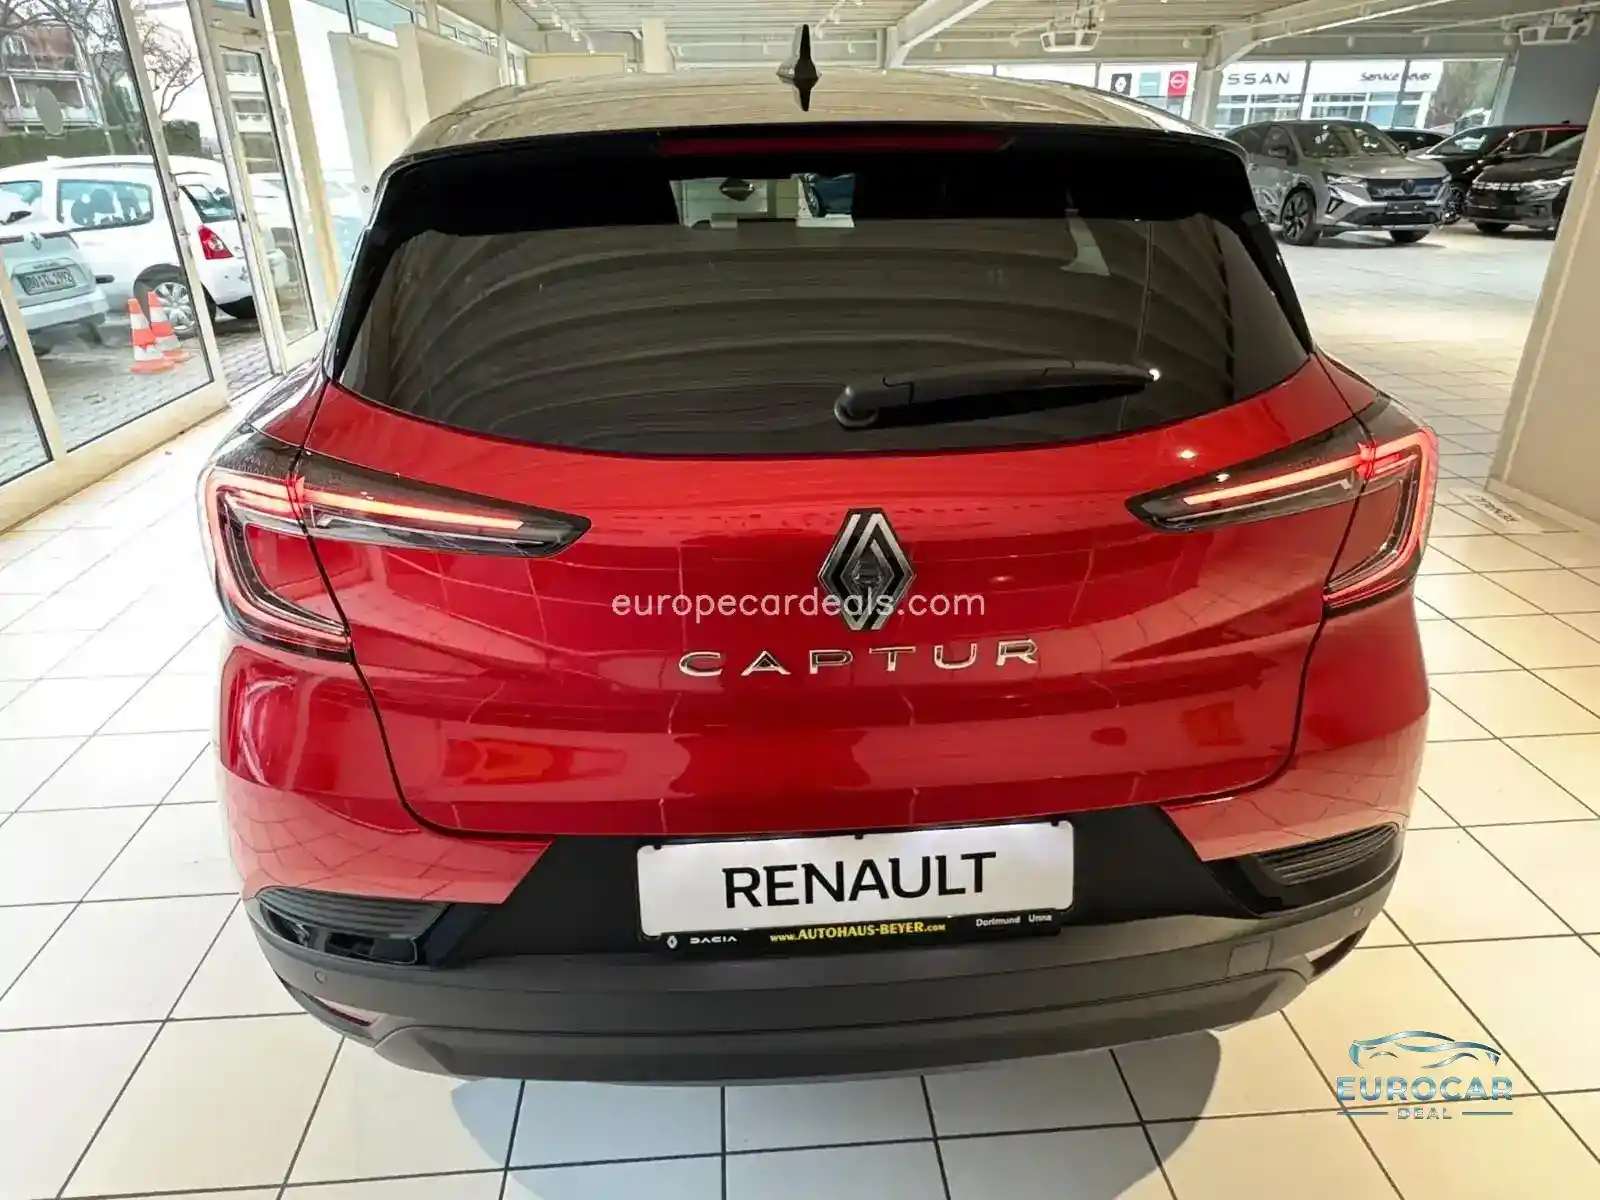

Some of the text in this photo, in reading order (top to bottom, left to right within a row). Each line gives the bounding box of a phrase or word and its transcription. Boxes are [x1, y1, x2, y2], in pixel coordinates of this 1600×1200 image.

[1227, 72, 1290, 86] SSAN
[678, 638, 1039, 677] CAPTUR
[722, 851, 996, 908] RENAULT
[690, 914, 1052, 944] DACIA www.AUTOHAUS-BEYER.com Dortmund Unna
